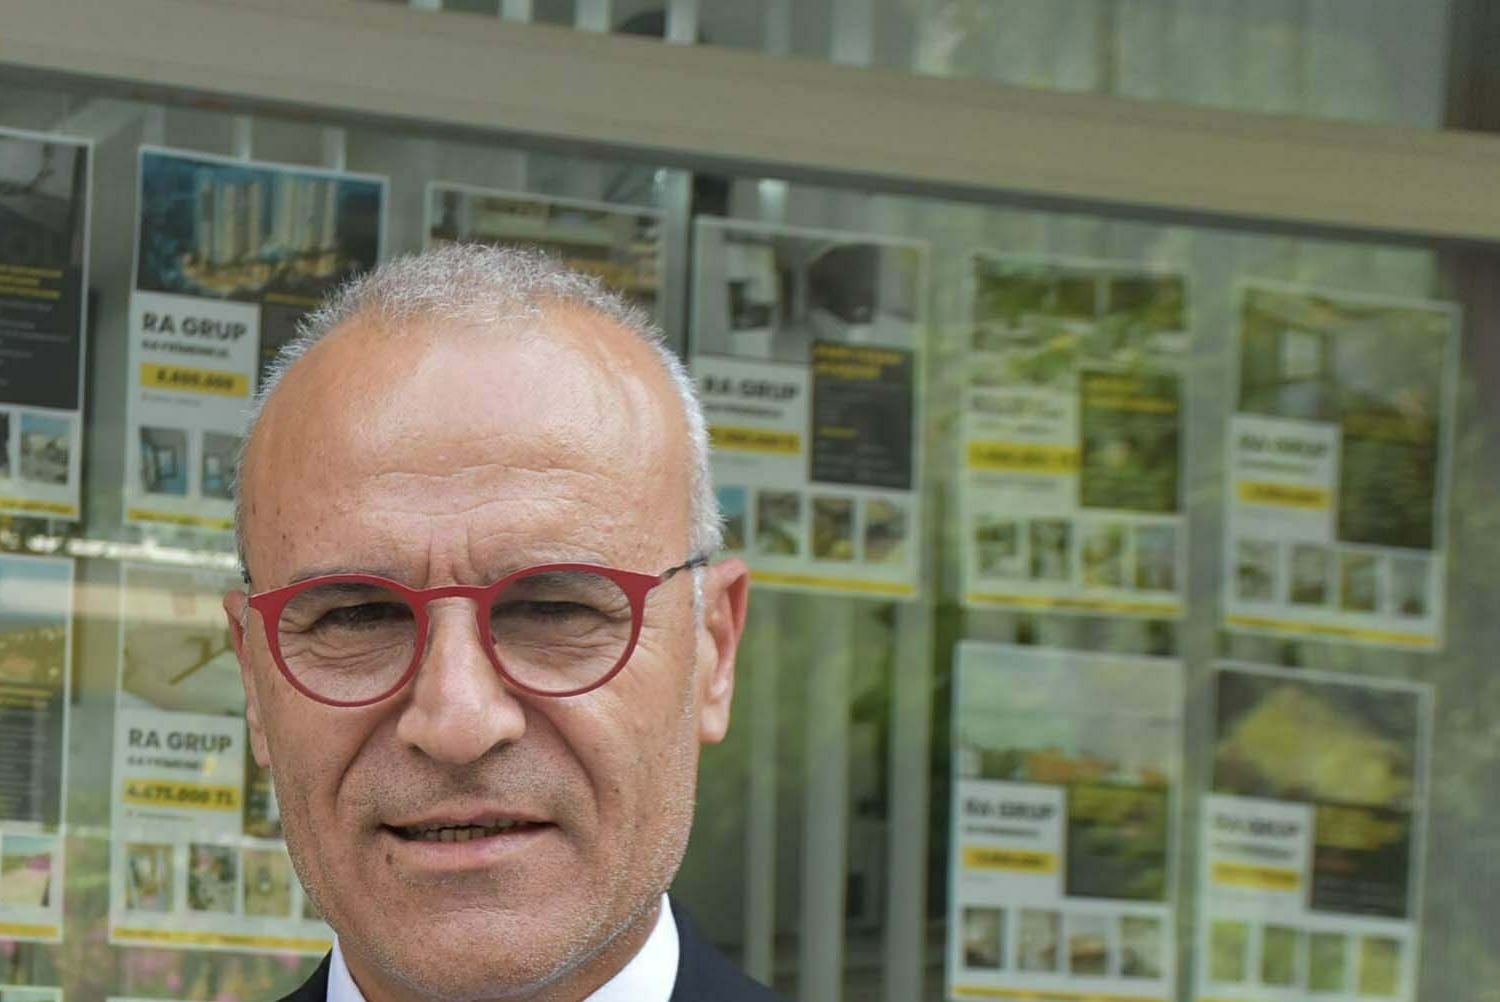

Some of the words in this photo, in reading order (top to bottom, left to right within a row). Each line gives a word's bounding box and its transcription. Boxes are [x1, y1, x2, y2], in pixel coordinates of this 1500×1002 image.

[142, 312, 176, 335] RA
[181, 316, 247, 342] GRUP
[128, 728, 160, 748] RA
[166, 731, 232, 754] GRUP
